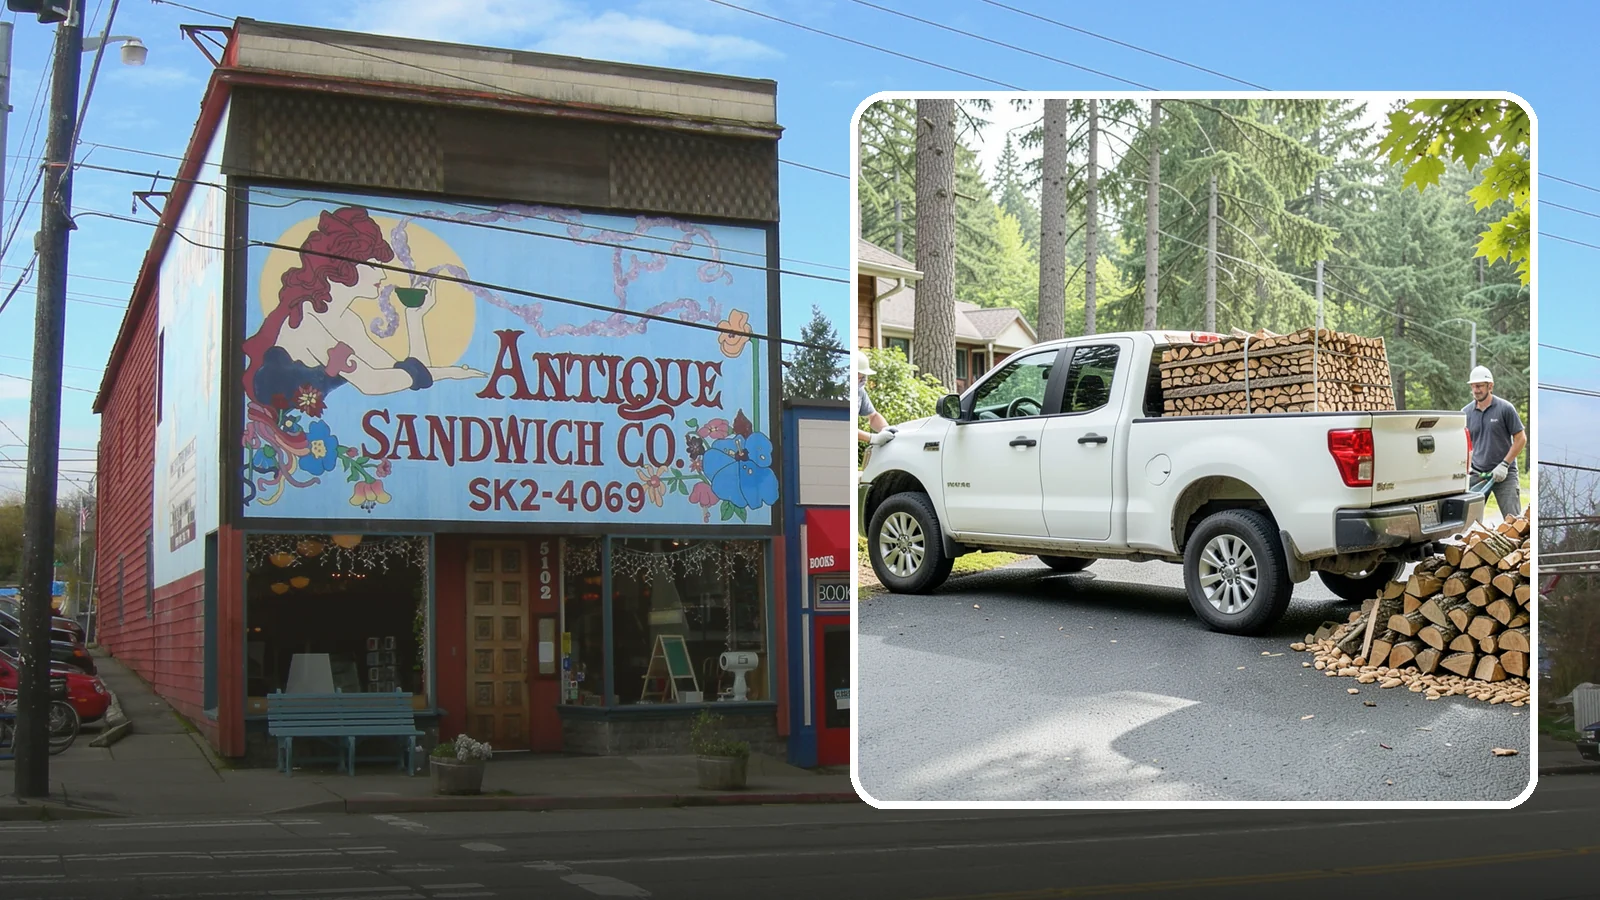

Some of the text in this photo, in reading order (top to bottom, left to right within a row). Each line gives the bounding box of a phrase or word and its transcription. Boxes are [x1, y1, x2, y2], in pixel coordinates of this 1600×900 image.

[475, 329, 724, 421] ANTIQUE
[361, 408, 686, 469] SANDWICH CO.
[468, 477, 645, 513] SK2-4069
[540, 541, 552, 600] 5102
[809, 554, 835, 569] BOOKS
